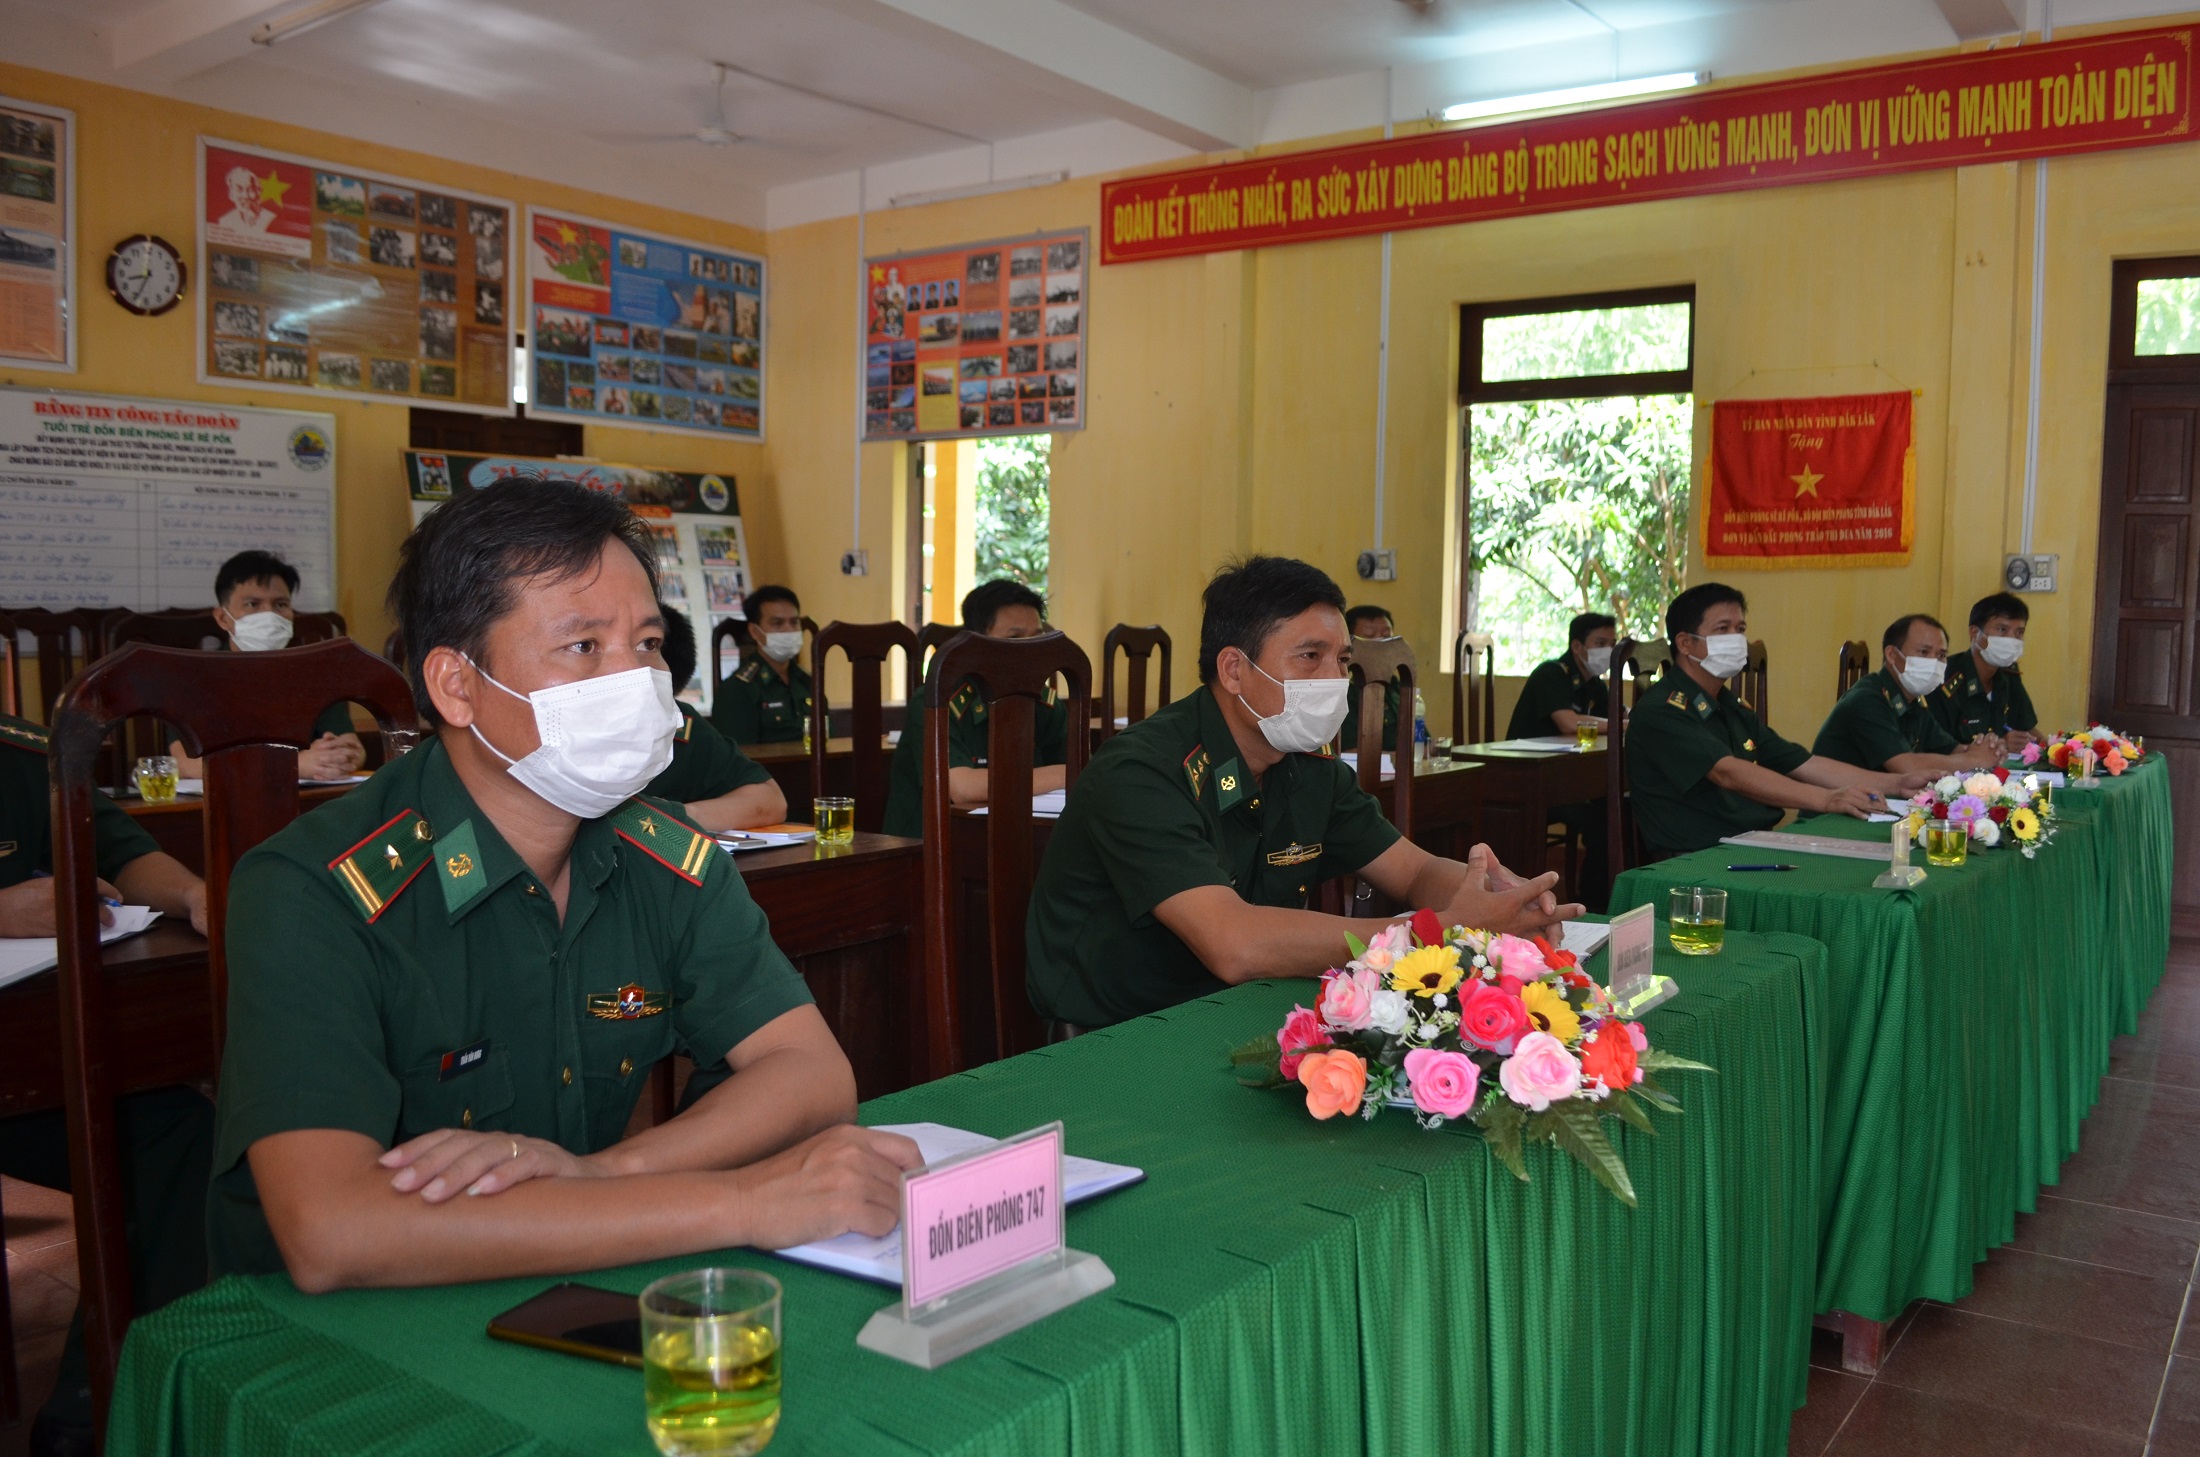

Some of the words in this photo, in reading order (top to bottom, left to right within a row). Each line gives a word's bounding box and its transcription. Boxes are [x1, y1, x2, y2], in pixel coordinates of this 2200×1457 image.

[1113, 194, 1154, 245] ĐOÀN
[1157, 184, 1185, 239] KẾT
[1188, 176, 1239, 235] THỐNG
[1243, 167, 1287, 228] NHẤT,
[1291, 178, 1313, 221] RA
[1317, 164, 1351, 218] SỨC
[1355, 159, 1389, 214] XÂY
[1394, 158, 1443, 217] DỰNG
[1447, 140, 1498, 201] ĐẢNG
[1503, 137, 1529, 203] BỘ
[1534, 137, 1598, 191] TRONG
[1604, 129, 1658, 191] SẠCH
[1664, 115, 1720, 174] VỮNG
[1727, 111, 1798, 175] MẠNH,
[1805, 100, 1852, 157] ĐƠN
[1859, 99, 1880, 160] VỊ
[1887, 84, 1950, 147] VỮNG
[1958, 79, 2032, 147] MẠNH
[2039, 61, 2106, 129] TOÀN
[2113, 52, 2177, 129] DIỆN
[85, 404, 113, 420] TIN
[1790, 433, 1824, 451] Tặng
[929, 1209, 953, 1260] ĐỒN
[956, 1203, 983, 1250] BIÊN
[986, 1189, 1024, 1238] PHÒNG
[1026, 1185, 1045, 1222] 747
